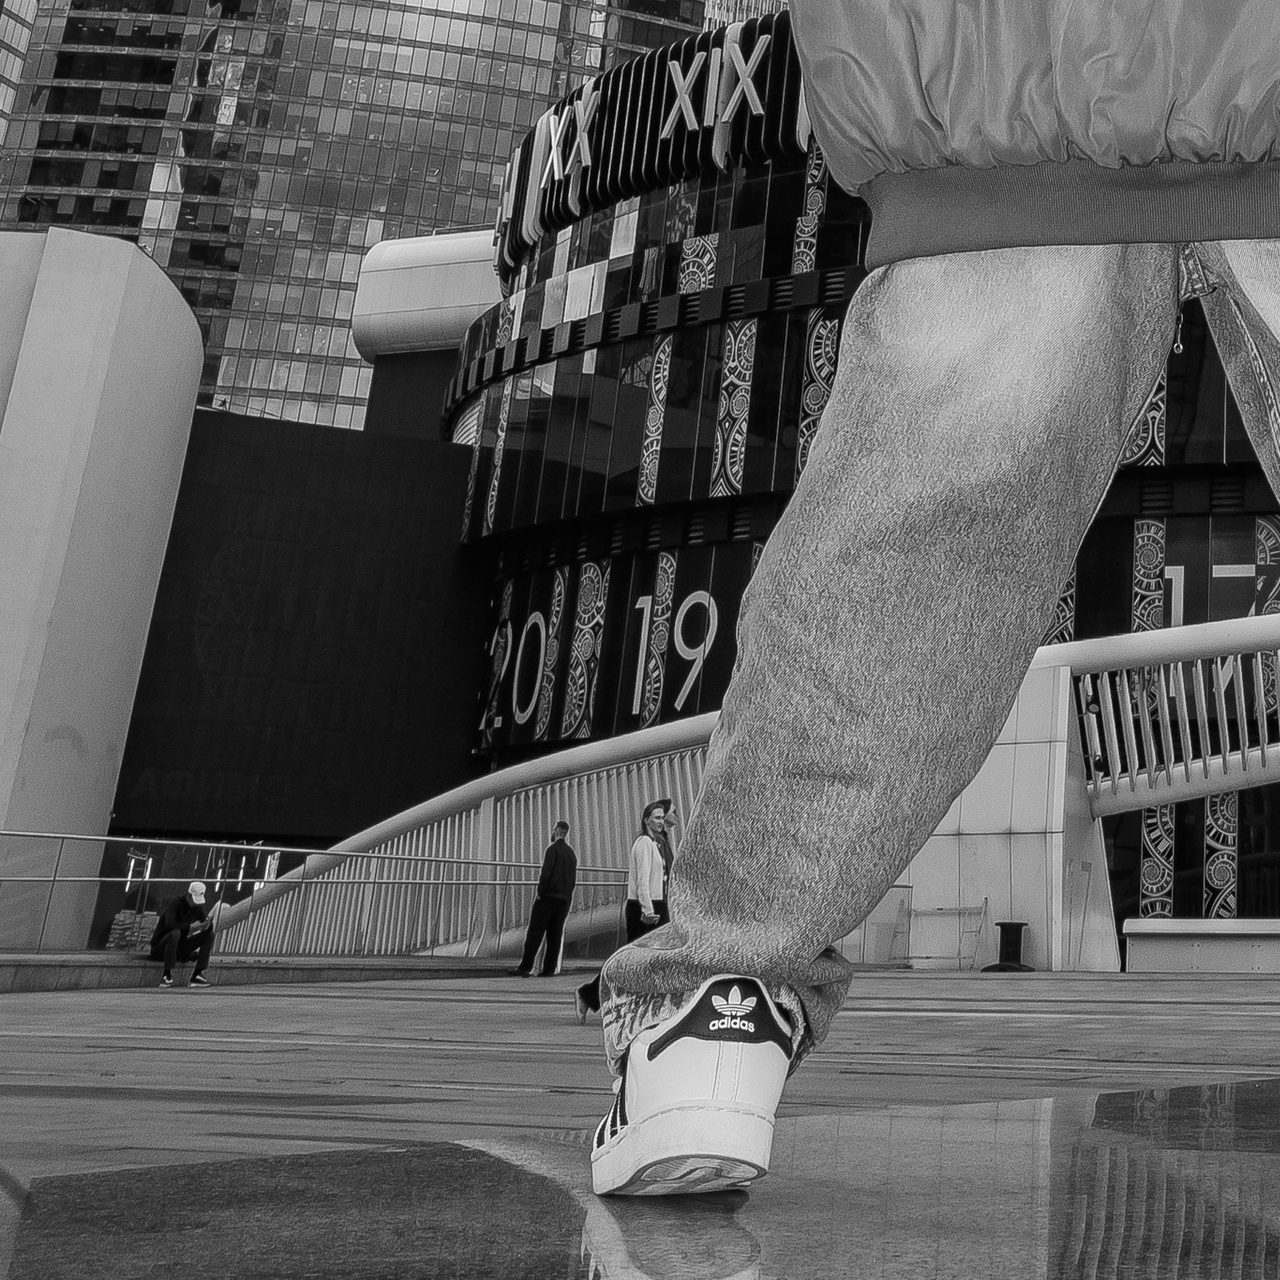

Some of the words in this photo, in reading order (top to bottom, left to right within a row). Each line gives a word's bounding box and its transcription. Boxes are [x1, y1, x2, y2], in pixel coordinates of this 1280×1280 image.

[660, 34, 771, 140] XIX
[540, 90, 600, 189] XX
[632, 590, 719, 716] 19
[709, 1016, 755, 1033] adidas
